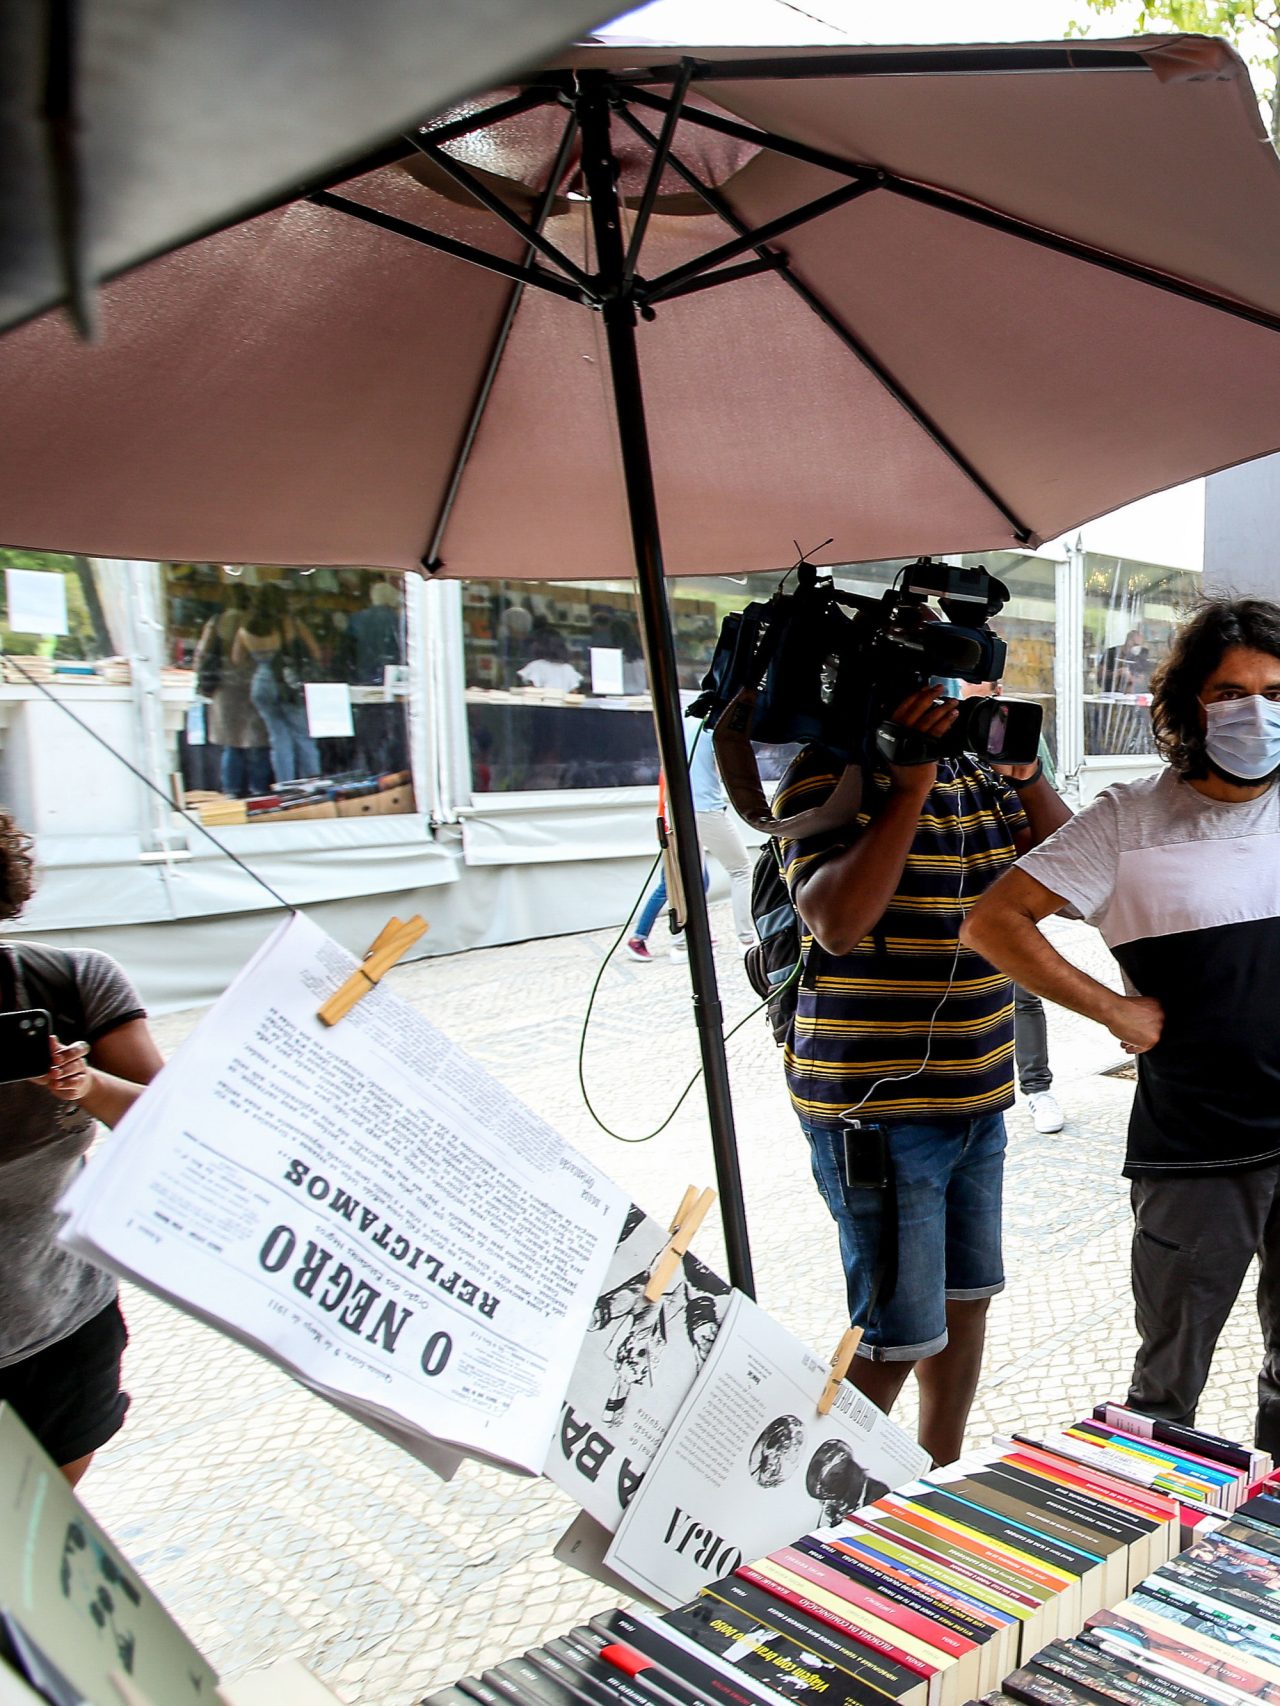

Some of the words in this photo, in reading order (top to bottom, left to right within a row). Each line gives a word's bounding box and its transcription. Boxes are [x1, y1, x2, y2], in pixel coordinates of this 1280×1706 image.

[258, 1224, 414, 1356] NEGRO
[420, 1331, 456, 1378] O
[560, 1400, 616, 1483] BA
[617, 1456, 647, 1510] A
[663, 1506, 743, 1578] ORJA
[707, 1617, 737, 1638] bolso
[847, 1623, 860, 1632] DA
[858, 1629, 894, 1650] FILOSOFIA
[740, 1636, 779, 1662] bran
[772, 1655, 795, 1672] com
[789, 1665, 831, 1693] Viagem
